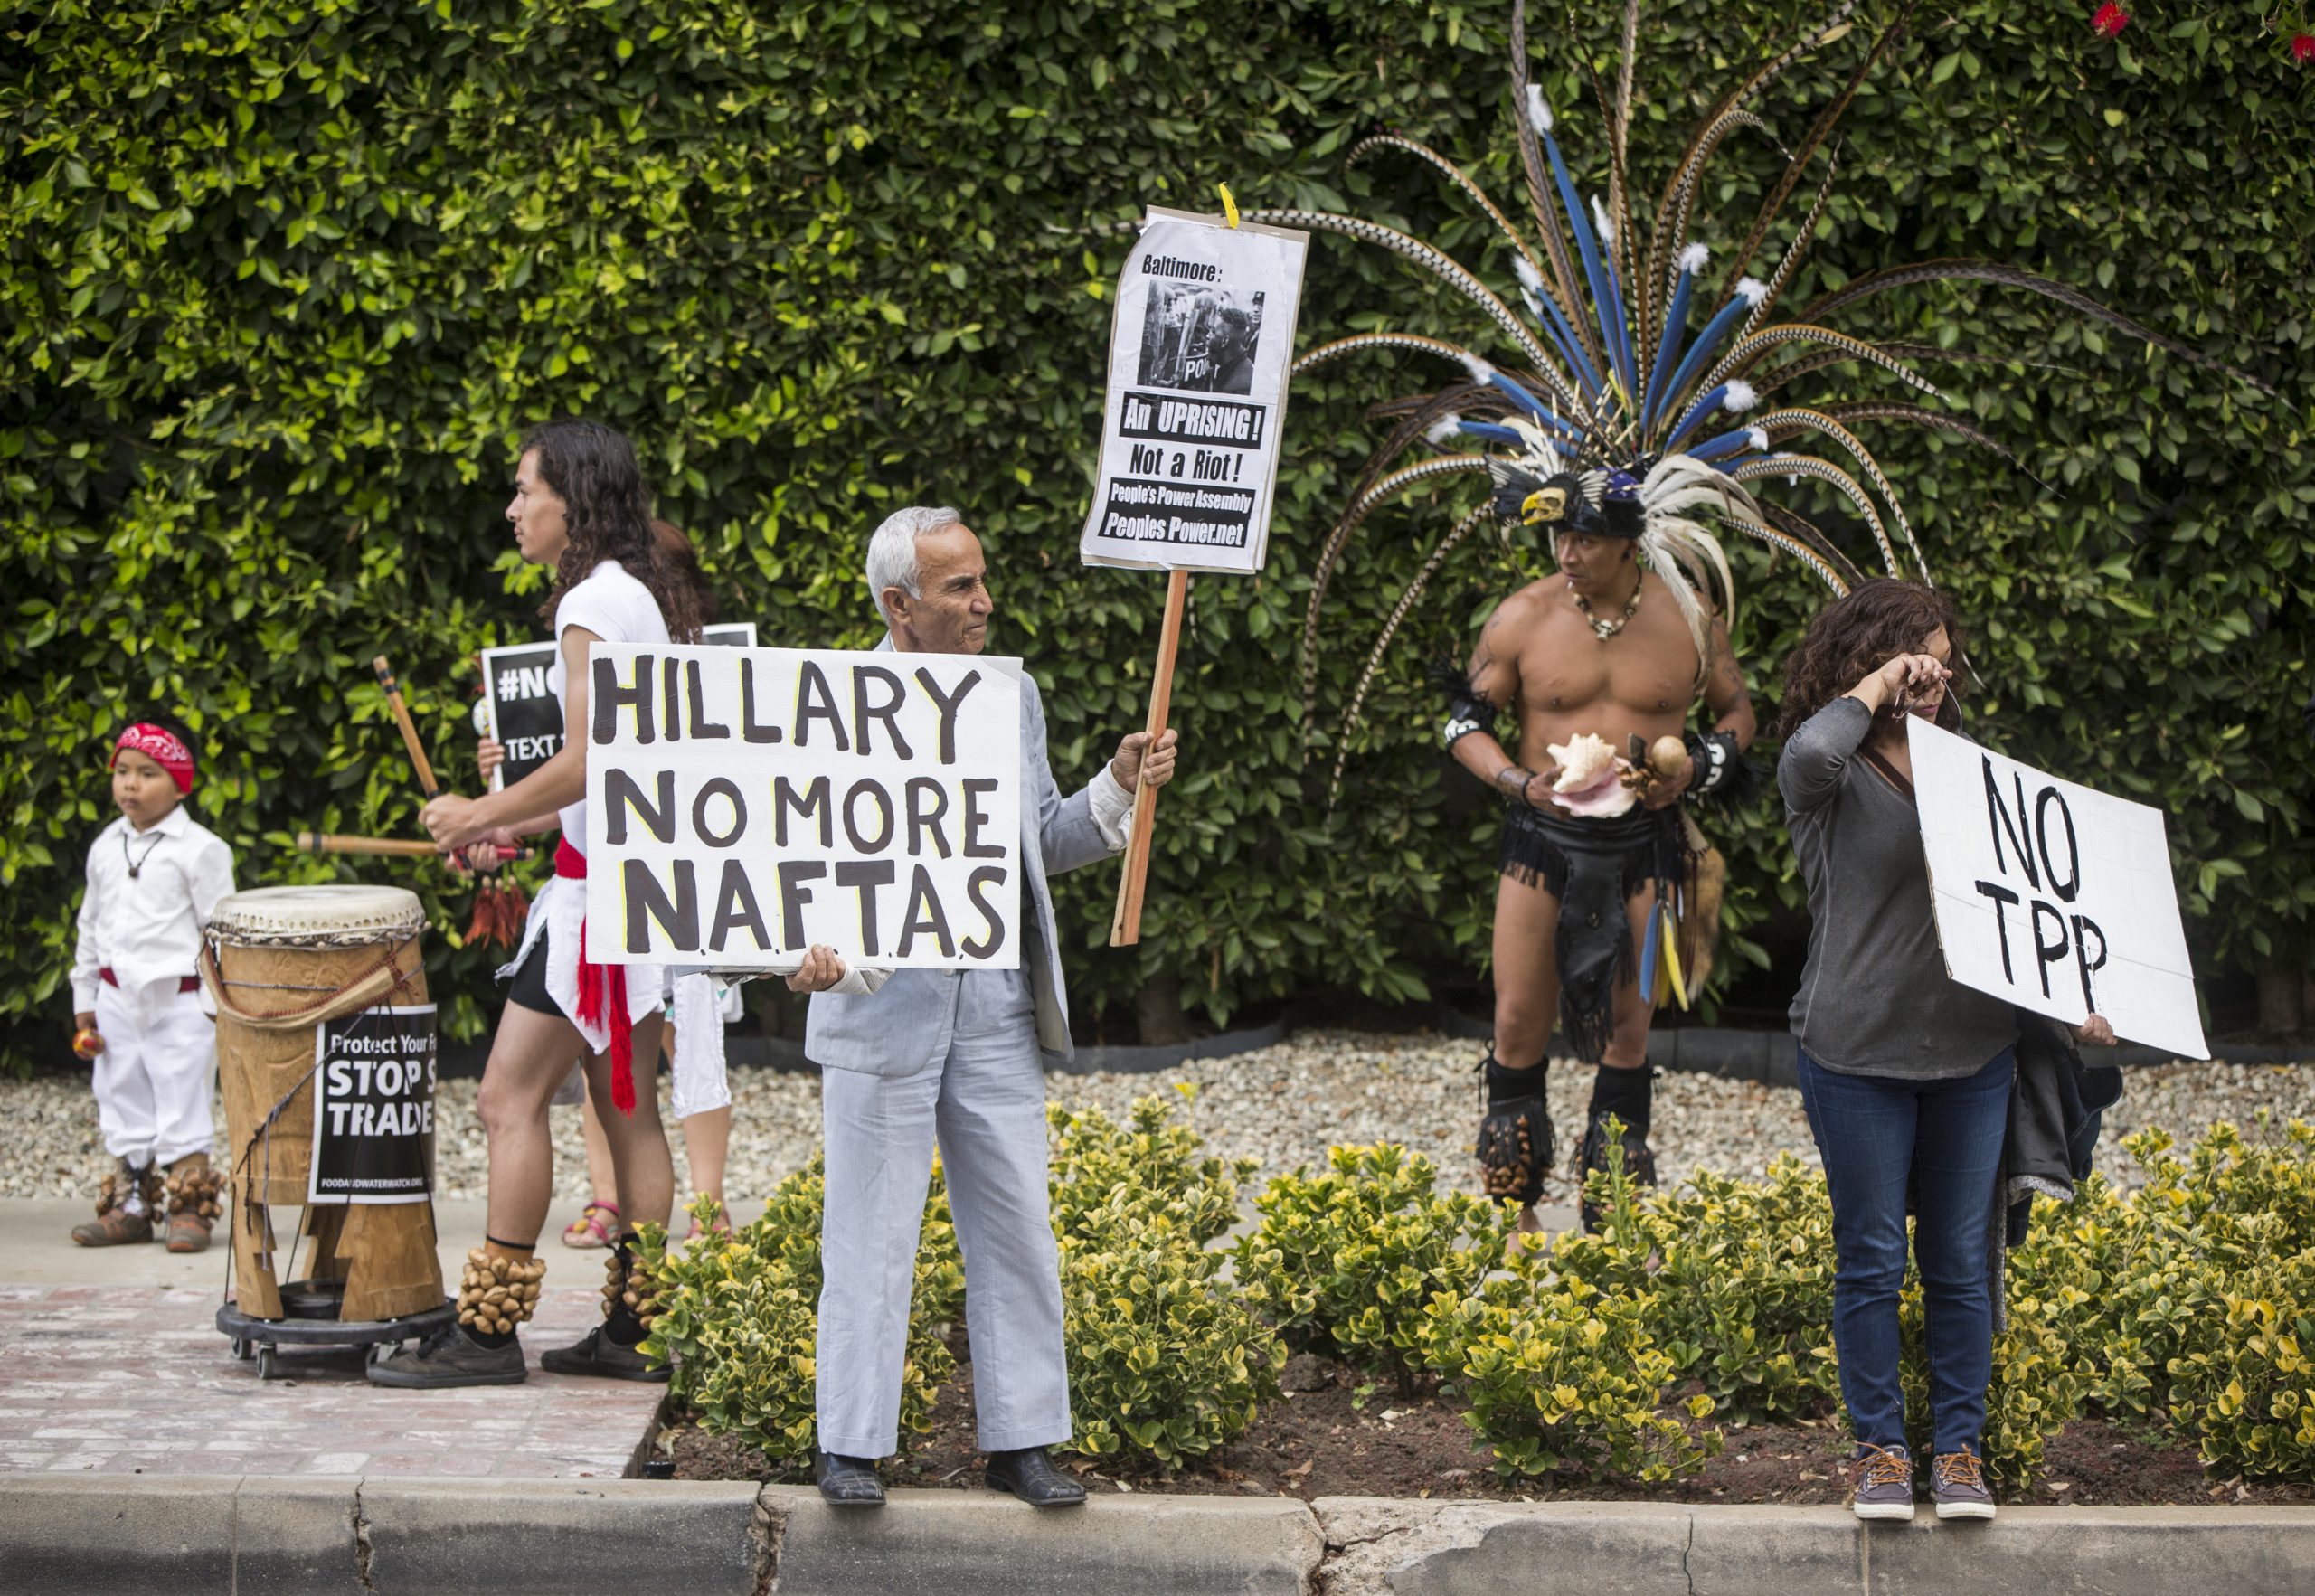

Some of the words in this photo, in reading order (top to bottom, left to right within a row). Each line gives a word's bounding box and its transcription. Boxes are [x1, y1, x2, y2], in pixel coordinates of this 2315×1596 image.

[1142, 254, 1222, 284] Baltimore:
[1123, 398, 1152, 430] An
[1129, 443, 1164, 476] Not
[1170, 452, 1186, 477] a
[1110, 482, 1157, 505] People's
[1158, 486, 1196, 507] Power
[1195, 489, 1252, 514] Assembly
[1103, 512, 1167, 541] Peoples
[1167, 516, 1243, 546] Power.net
[591, 654, 982, 765] HILLARY
[505, 733, 557, 761] TEXT
[604, 769, 748, 848] NO
[773, 775, 1006, 859] MORE
[1981, 751, 2080, 903] NO
[1974, 879, 2108, 1015] TPP
[330, 1034, 398, 1054] Protect
[400, 1034, 429, 1054] Your
[327, 1059, 422, 1097] STOP
[327, 1100, 433, 1137] TRADE
